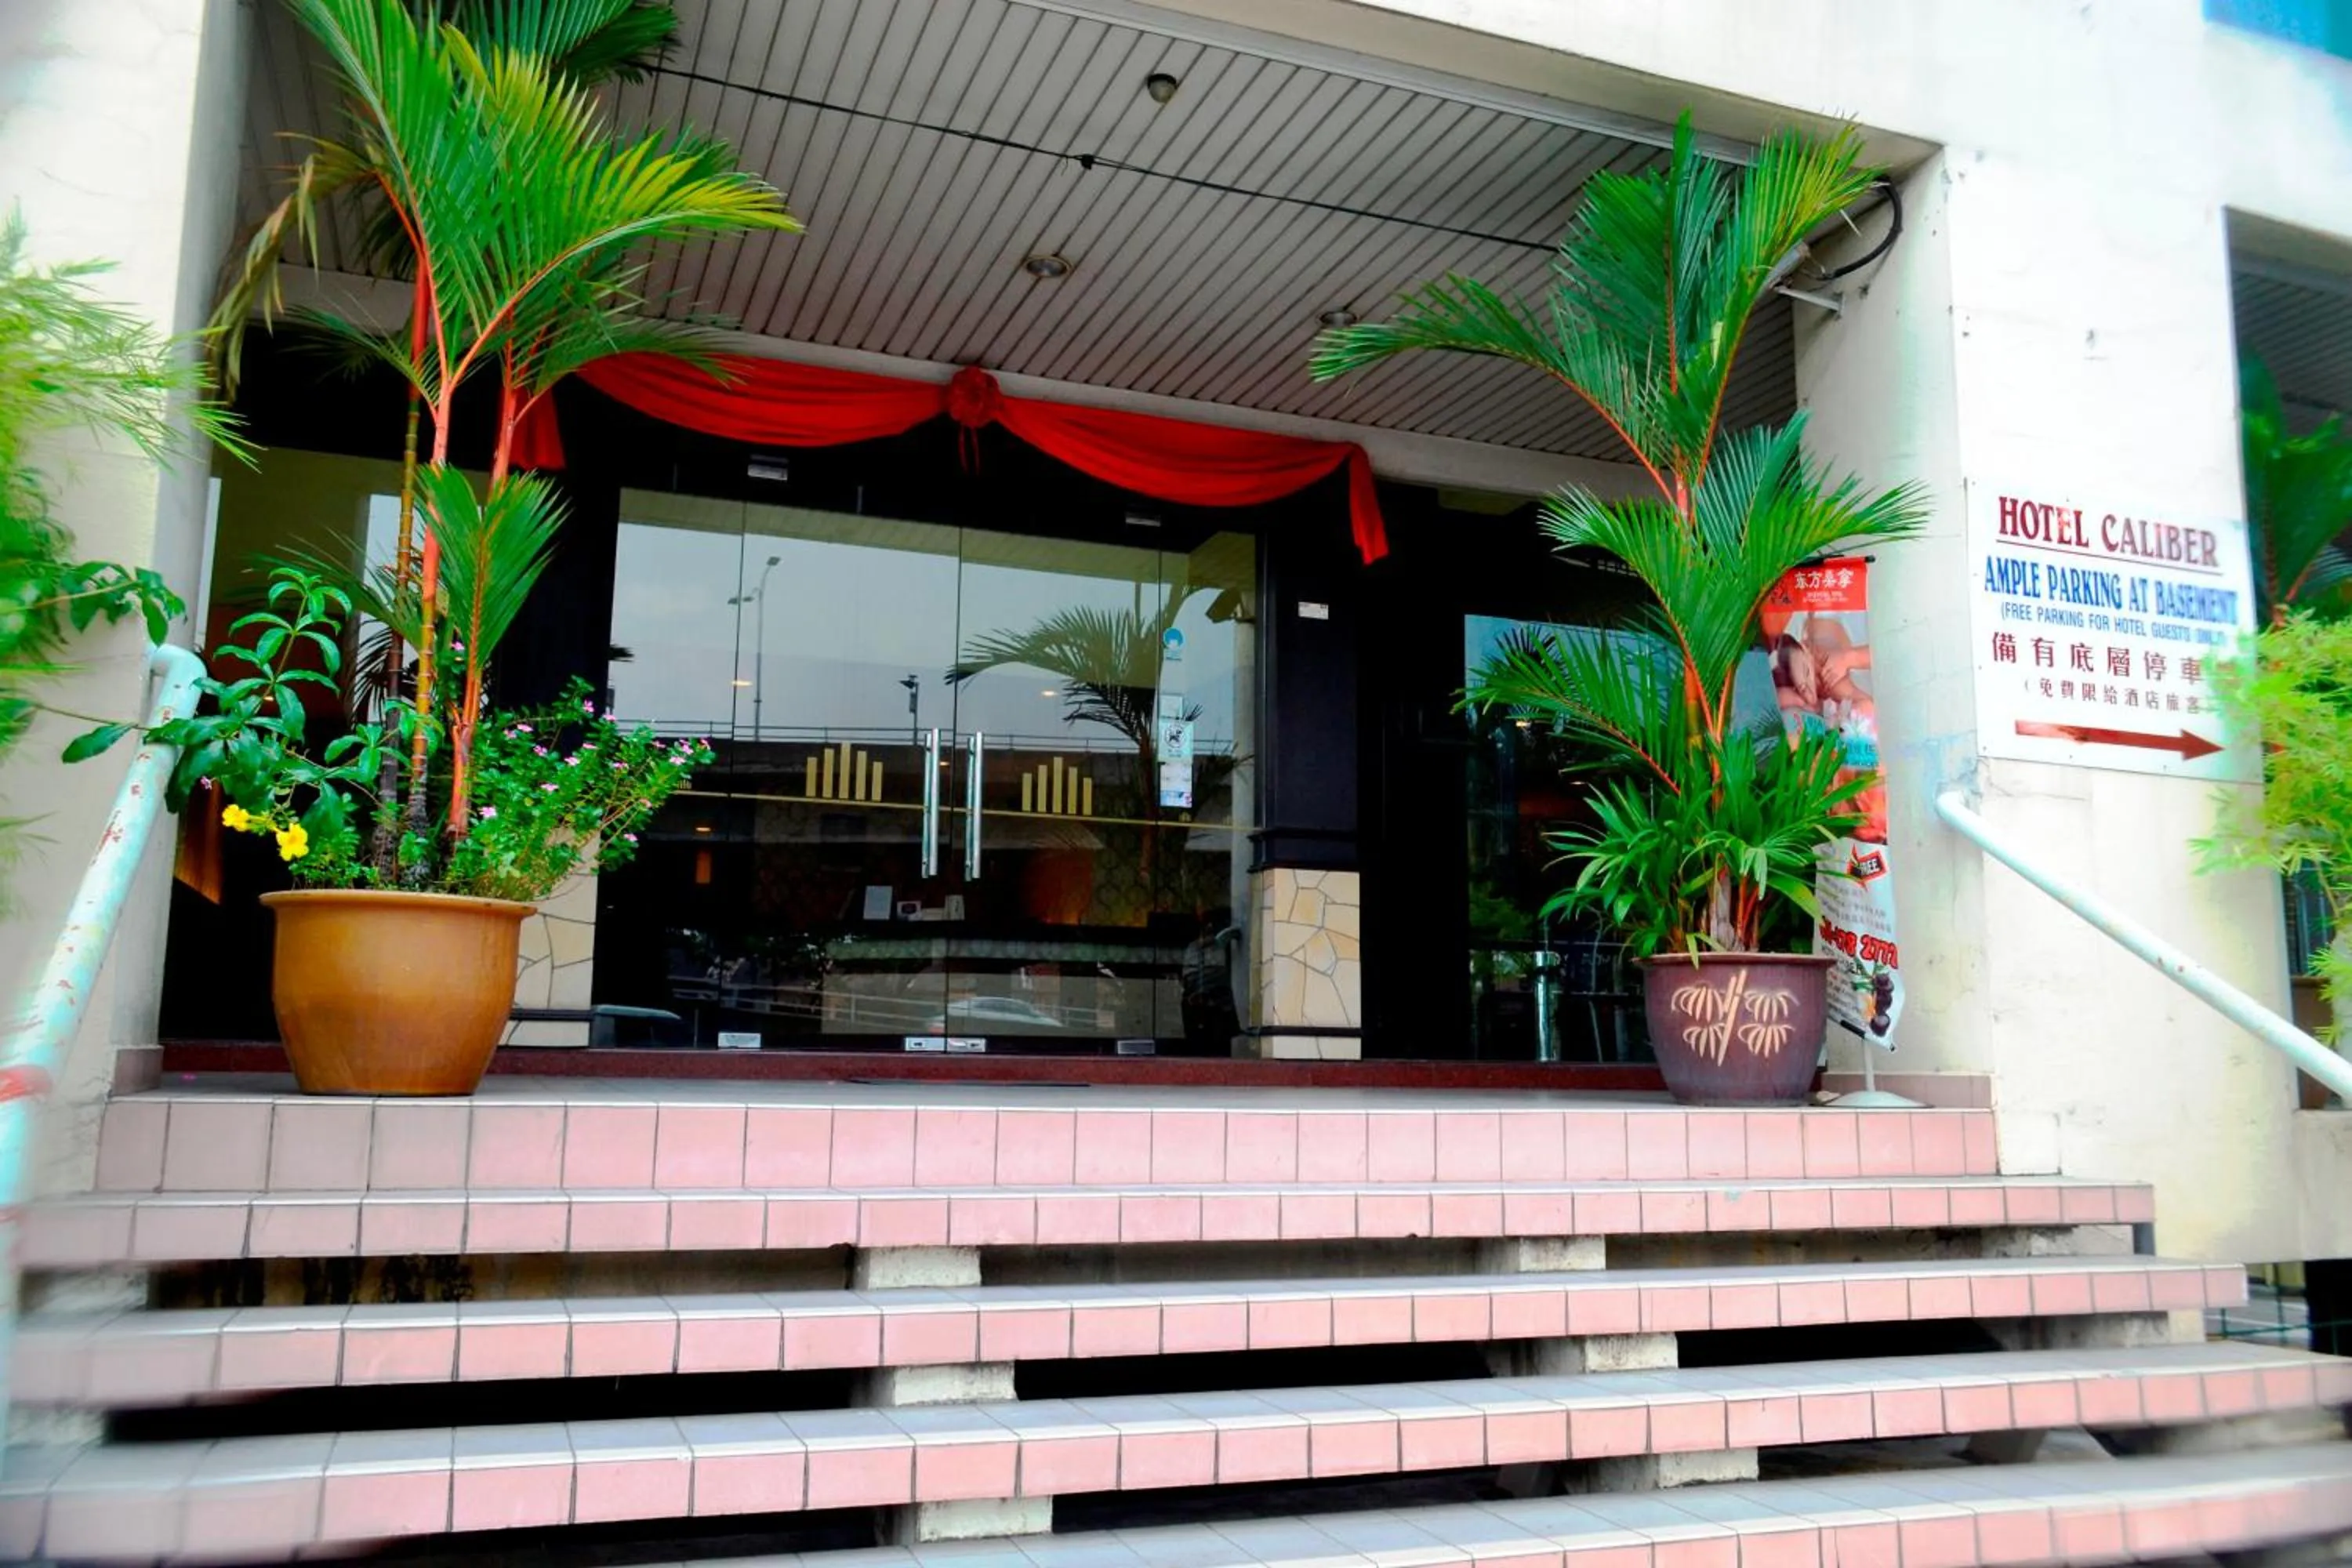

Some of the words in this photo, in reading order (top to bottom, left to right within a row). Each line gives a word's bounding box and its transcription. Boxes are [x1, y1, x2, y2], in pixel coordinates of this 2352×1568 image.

[1998, 495, 2089, 548] HOTEL
[2101, 514, 2219, 568] CALIBER
[1984, 555, 2041, 598] AMPLE
[2047, 564, 2122, 609] PARKING
[2129, 577, 2148, 613] AT
[2154, 580, 2238, 626] BASEMENT
[2001, 601, 2032, 621] (FREE
[2037, 606, 2084, 628] PARKING
[2089, 613, 2110, 630] FOR
[2114, 616, 2147, 637] HOTEL
[2151, 622, 2191, 642] GUESTS
[1992, 631, 2241, 686] 備有底層停車
